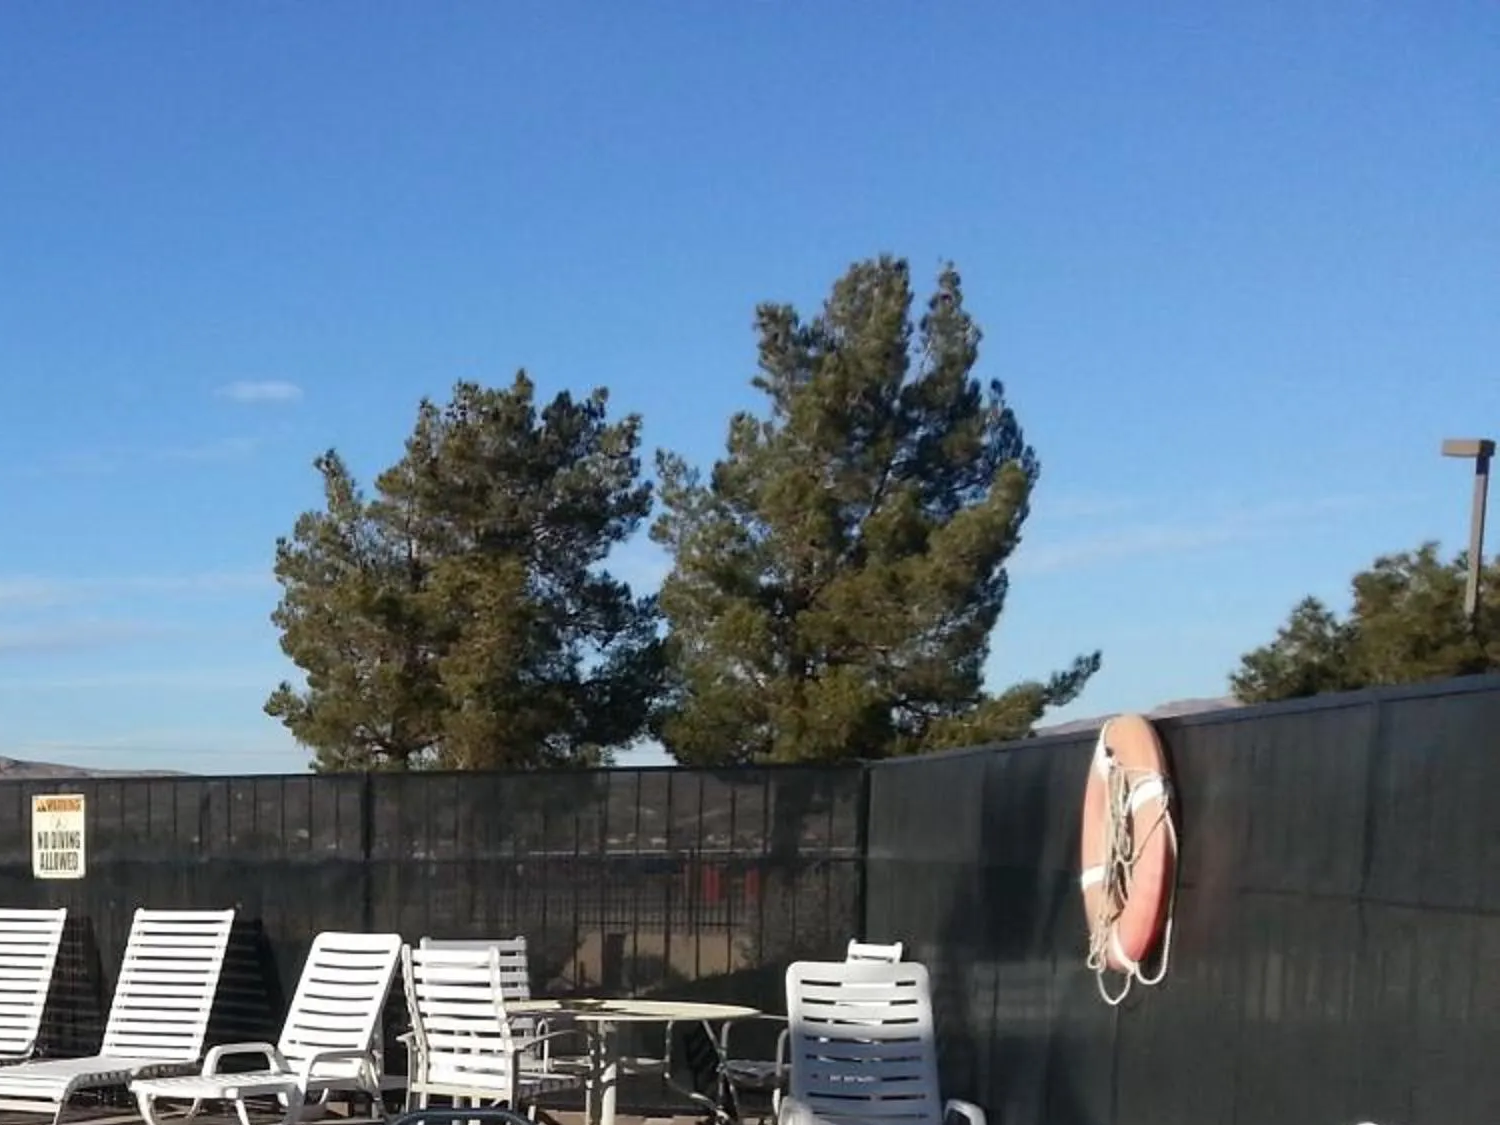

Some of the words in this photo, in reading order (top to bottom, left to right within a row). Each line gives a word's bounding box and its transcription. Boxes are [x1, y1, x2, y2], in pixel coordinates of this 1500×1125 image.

[37, 831, 49, 849] NO
[51, 831, 81, 849] DIVING
[40, 851, 79, 870] ALLOWED
